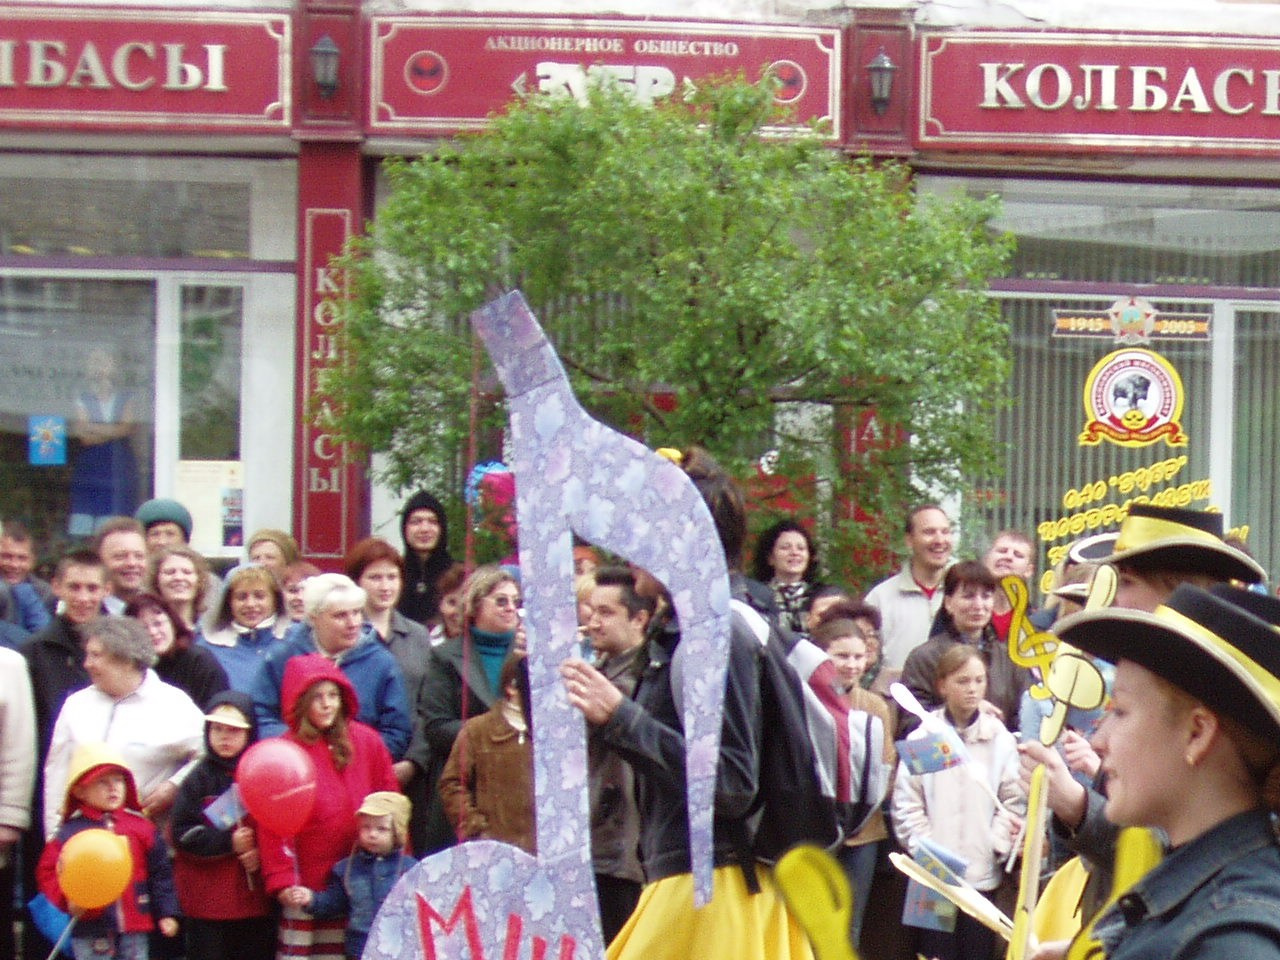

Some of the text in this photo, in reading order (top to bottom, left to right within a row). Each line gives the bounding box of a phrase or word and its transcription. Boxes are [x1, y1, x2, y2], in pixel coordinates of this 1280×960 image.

[484, 36, 739, 56] АКЦИОНЕРНОЕ ОБЩЕСТВО
[1070, 317, 1196, 335] 1945 2005
[1063, 480, 1107, 509] ОАО
